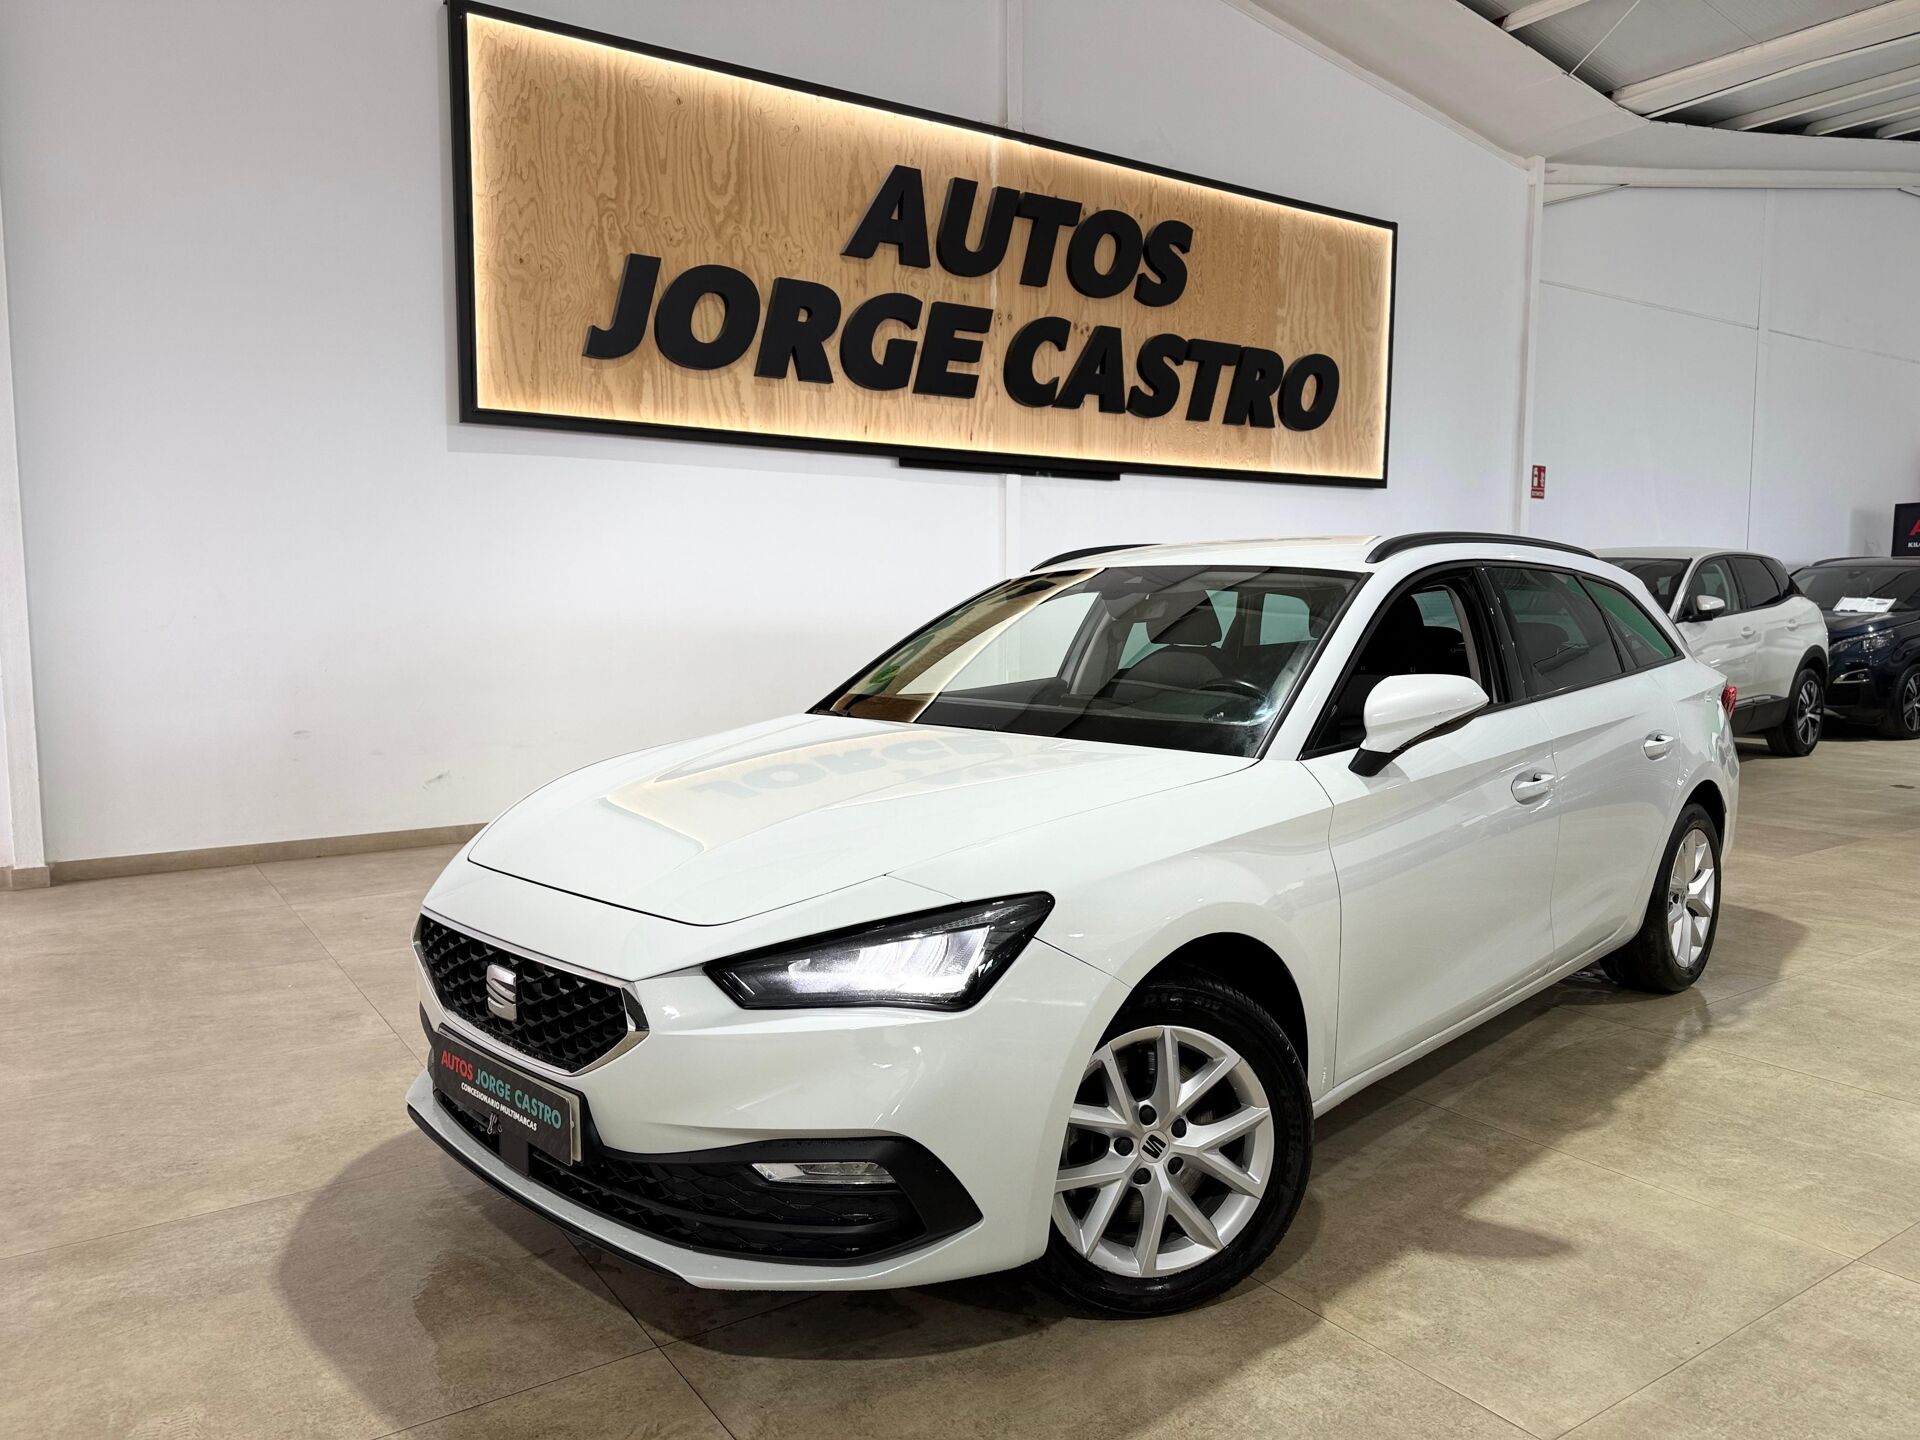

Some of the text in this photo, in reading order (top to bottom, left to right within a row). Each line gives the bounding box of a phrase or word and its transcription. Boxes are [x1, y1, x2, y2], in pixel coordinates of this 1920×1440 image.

[840, 165, 1194, 308] AUTOS
[582, 253, 1341, 431] JORGE CASTRO
[441, 1051, 562, 1129] AUTOS JORGE CASTRO
[460, 1082, 538, 1131] CONCESIONARIO MULTIMARCAS
